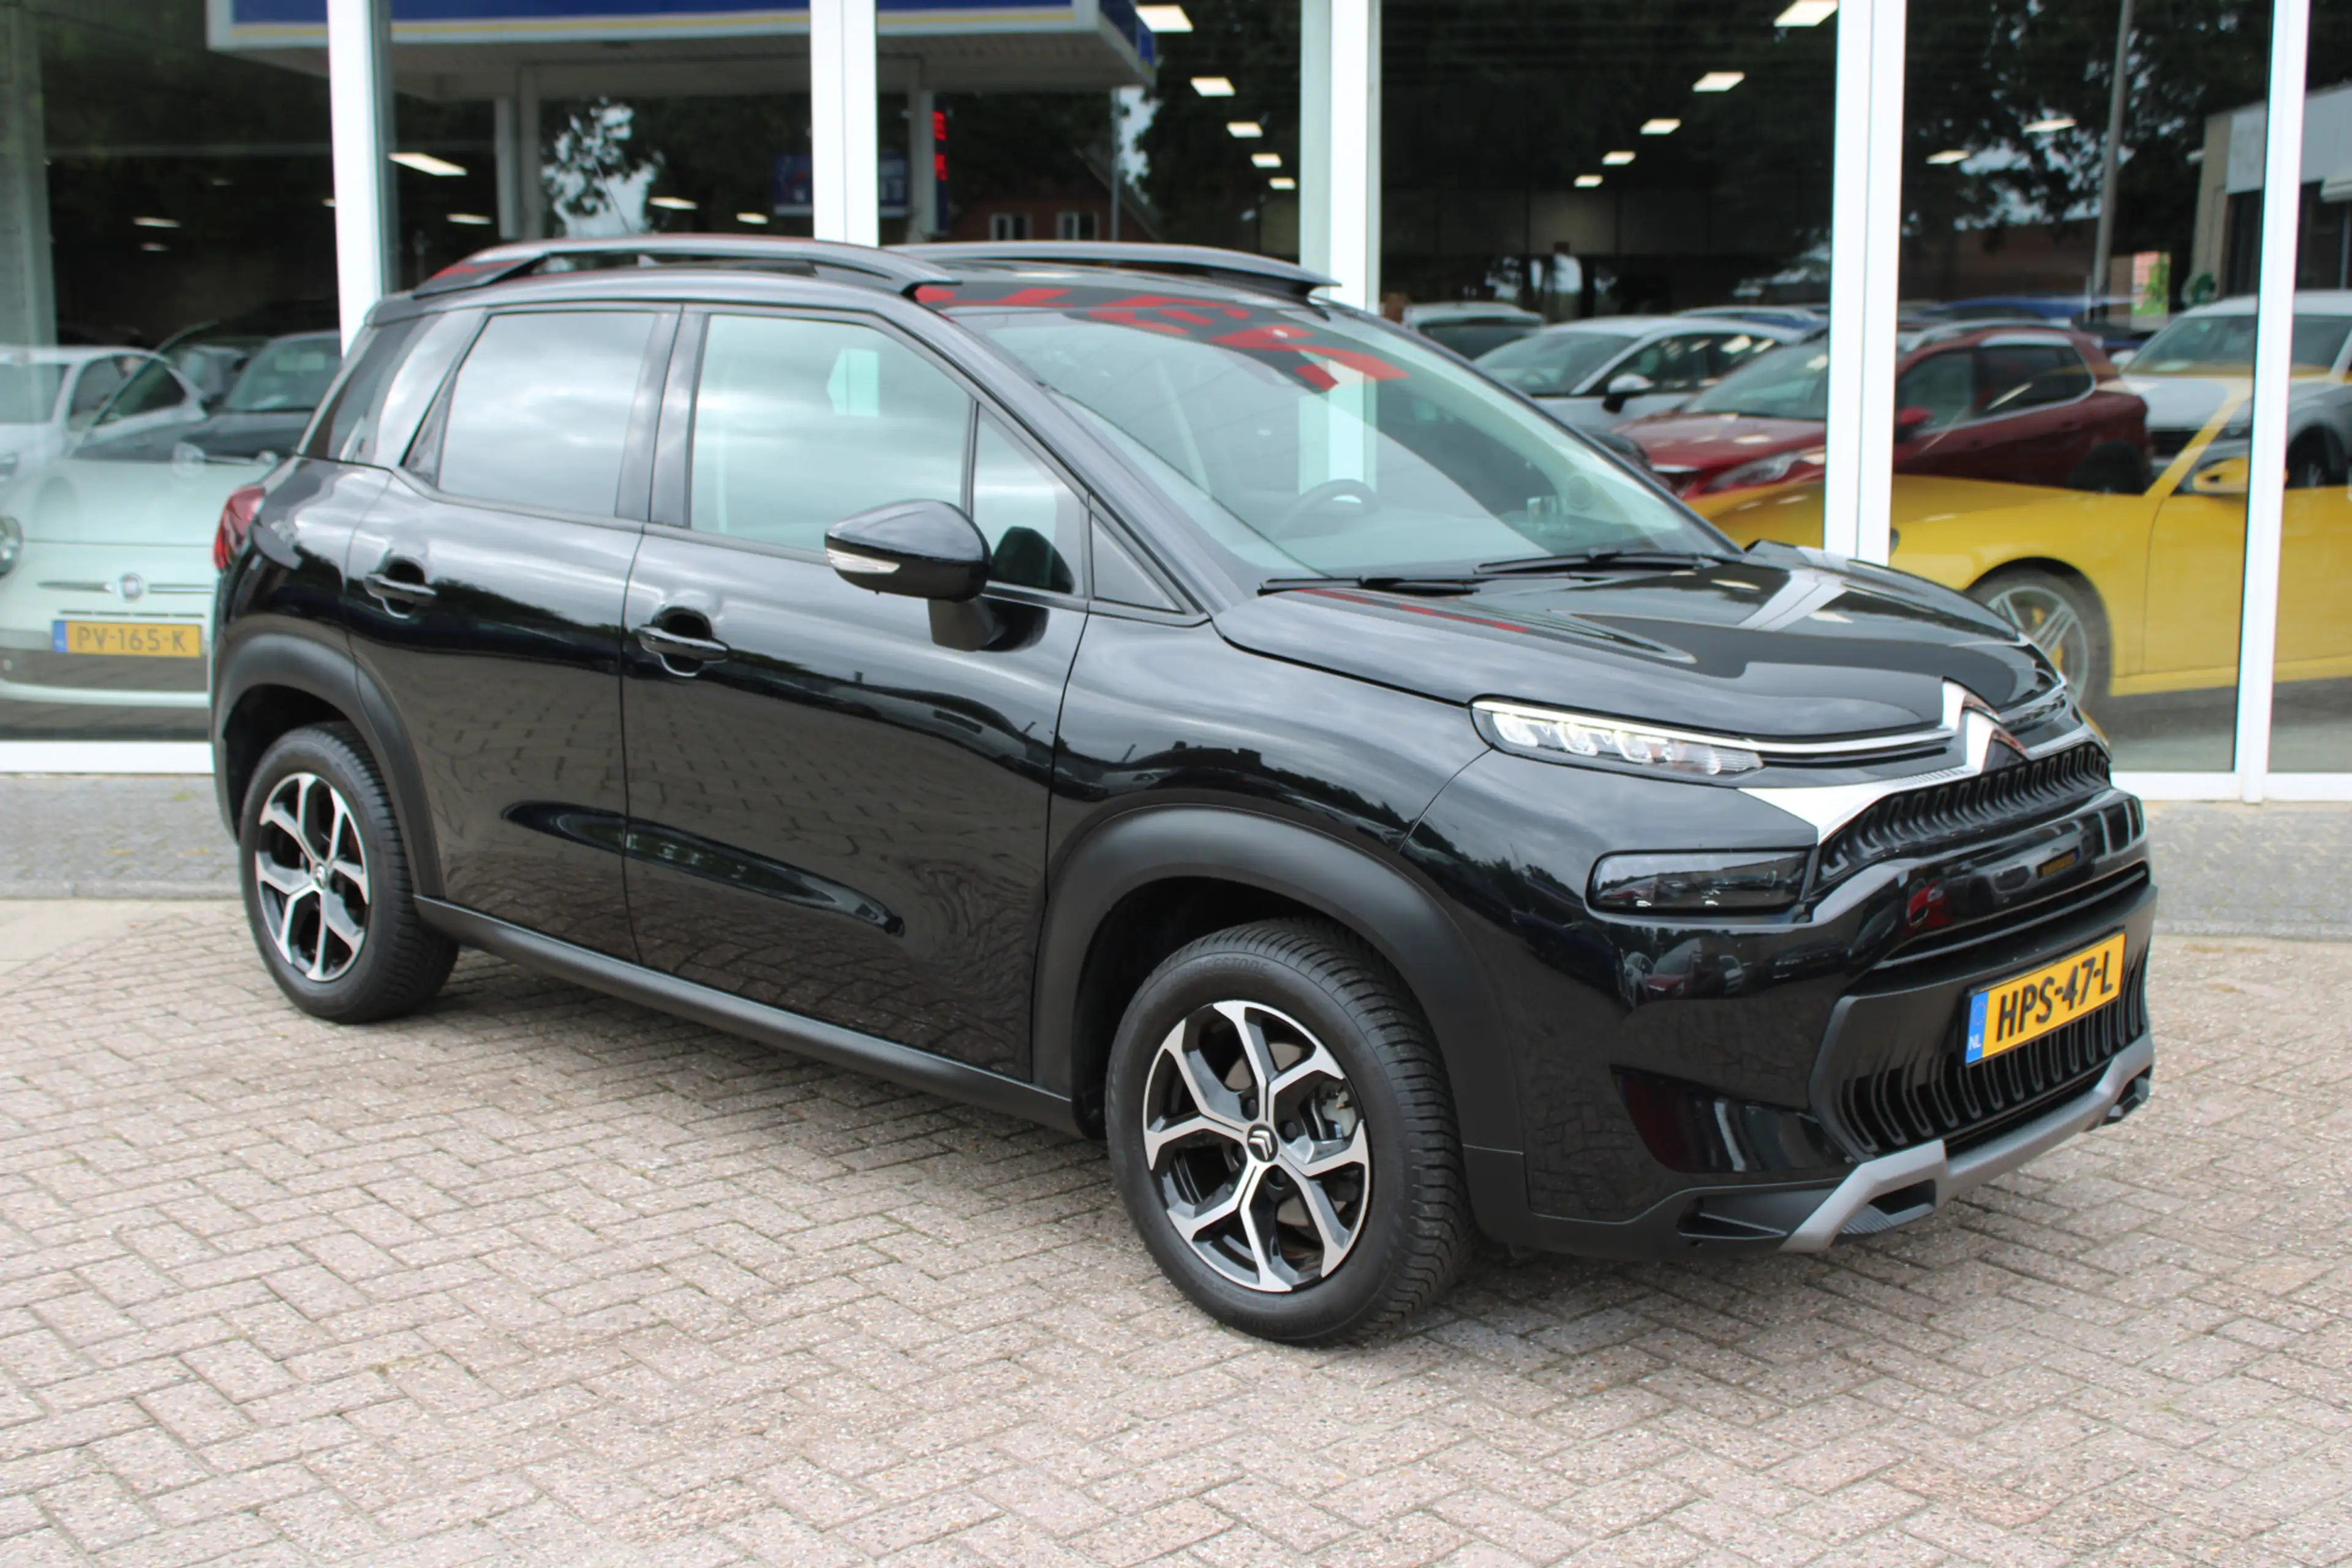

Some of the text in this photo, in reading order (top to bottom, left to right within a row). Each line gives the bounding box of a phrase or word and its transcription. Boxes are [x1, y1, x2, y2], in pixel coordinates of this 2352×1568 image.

[78, 627, 185, 652] PV-165-K
[1997, 951, 2112, 1041] HPS-47-L
[1968, 1035, 1982, 1051] NL
